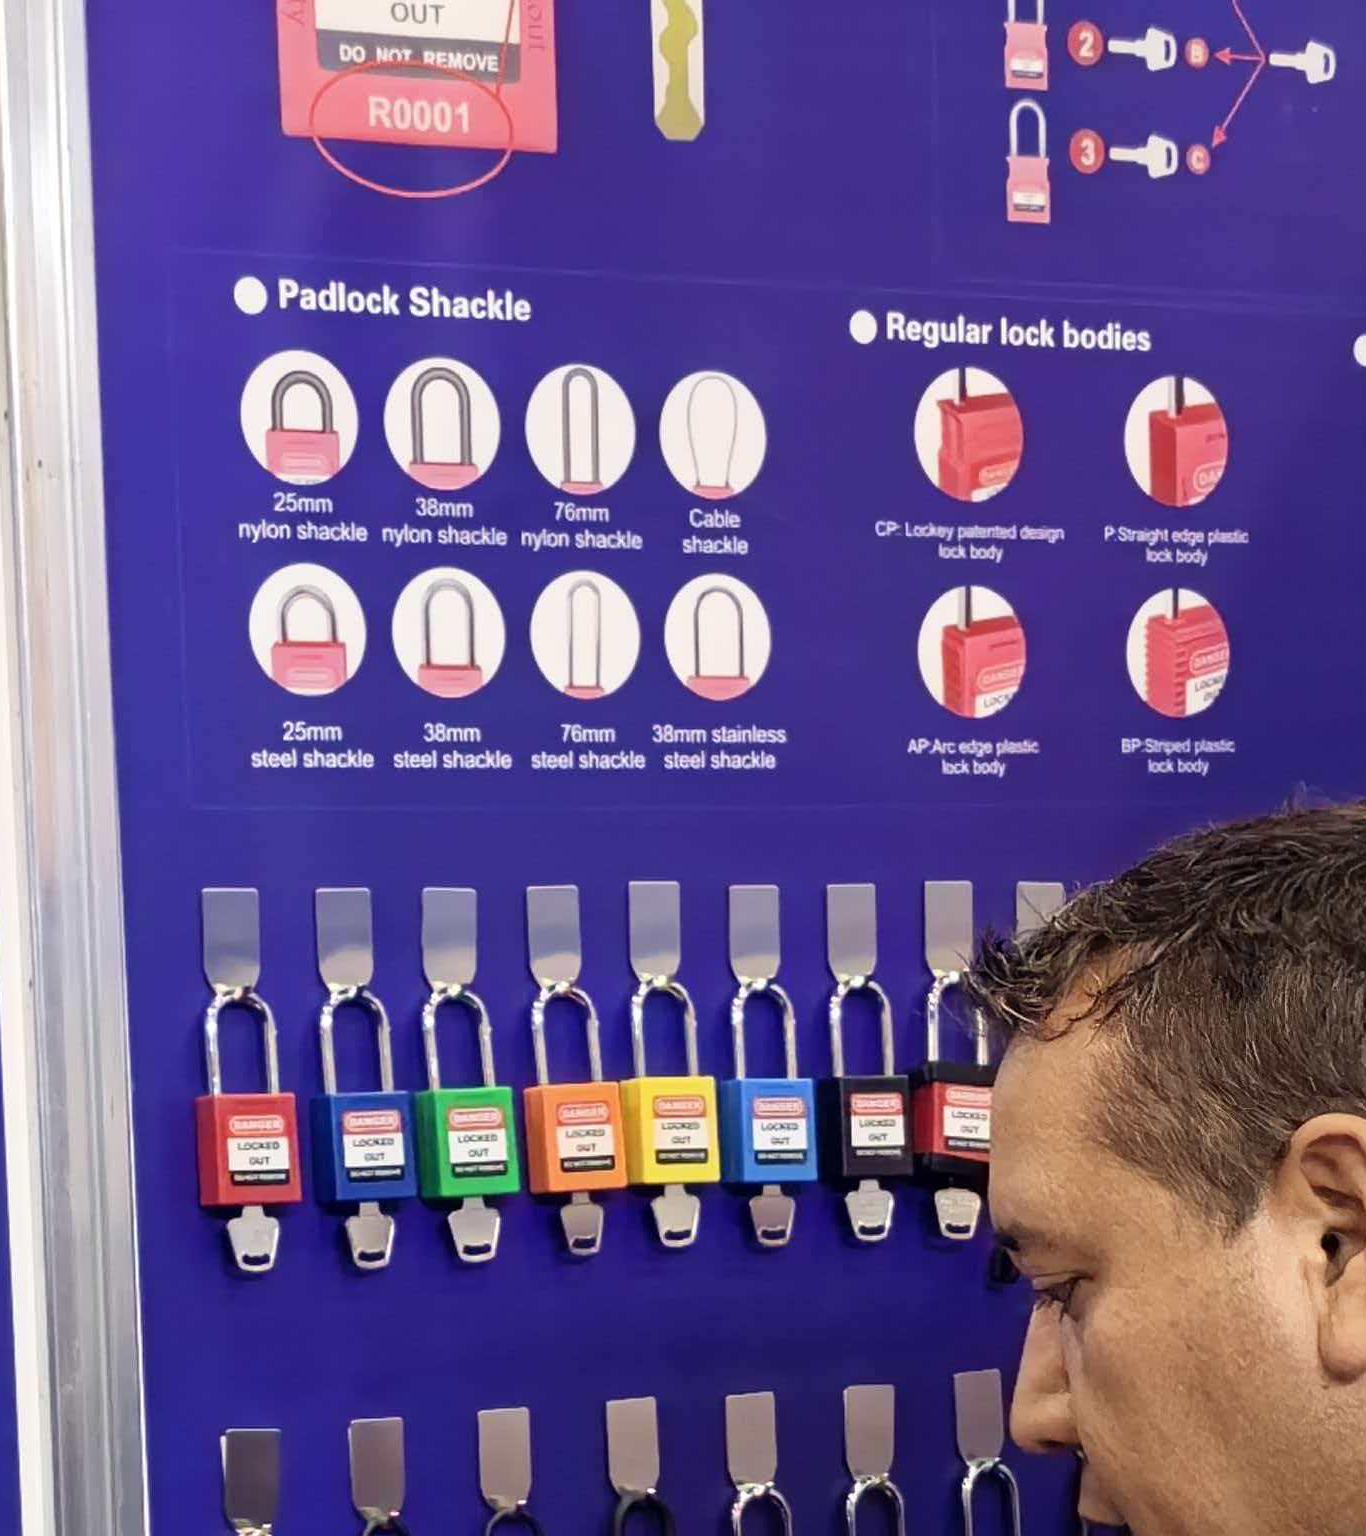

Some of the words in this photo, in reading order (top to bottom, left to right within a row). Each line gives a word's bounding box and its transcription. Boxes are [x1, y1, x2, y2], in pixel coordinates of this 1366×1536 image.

[391, 2, 445, 24] OUT
[1079, 31, 1095, 57] 2
[339, 44, 366, 63] DO
[377, 48, 414, 64] NOT
[424, 52, 500, 73] REMOVE
[368, 96, 470, 134] R0001
[1080, 138, 1096, 165] 3
[278, 279, 399, 317] Padlock
[409, 286, 532, 322] Shackle
[887, 312, 992, 348] Regular
[1000, 318, 1055, 348] lock
[1063, 320, 1152, 352] bodies
[273, 492, 333, 513] 25mm
[415, 497, 474, 518] 38mm
[554, 502, 609, 522] 76mm
[689, 508, 741, 529] Cable
[238, 520, 291, 543] nylon
[297, 521, 368, 542] shackle
[382, 524, 432, 547] nylon
[438, 525, 507, 546] shackle
[521, 529, 569, 551] nylon
[575, 529, 643, 550] shackle
[905, 522, 954, 542] Lockey
[958, 525, 1017, 541] patented
[1020, 526, 1065, 544] design
[1171, 529, 1205, 547] edge
[1208, 528, 1250, 547] plastic
[683, 535, 749, 555] shackle
[939, 543, 966, 559] lock
[970, 544, 1003, 564] body
[1146, 548, 1173, 563] lock
[1176, 549, 1208, 567] body
[283, 721, 343, 741] 25mm
[423, 723, 482, 742] 38mm
[560, 724, 616, 743] 76mm
[652, 724, 706, 743] 38mm
[712, 725, 787, 743] stainless
[958, 739, 993, 758] edge
[996, 739, 1040, 757] plastic
[1194, 738, 1236, 757] plastic
[251, 749, 297, 768] steel
[303, 749, 375, 768] shackle
[393, 750, 437, 769] steel
[443, 750, 513, 769] shackle
[531, 750, 573, 769] steel
[579, 750, 646, 769] shackle
[664, 750, 705, 769] steel
[710, 750, 776, 769] shackle
[941, 759, 969, 775] lock
[973, 760, 1006, 777] body
[1147, 759, 1174, 773] lock
[1177, 759, 1209, 777] body
[565, 1128, 605, 1138] LOCKED
[661, 1121, 700, 1131] LOCKED
[761, 1122, 799, 1132] LOCKED
[858, 1119, 896, 1128] LOCKED
[237, 1140, 280, 1151] LOCKED
[352, 1137, 395, 1148] LOCKED
[457, 1133, 498, 1143] LOCKED
[575, 1143, 597, 1152] OUT
[671, 1136, 692, 1145] OUT
[249, 1156, 271, 1166] OUT
[364, 1152, 386, 1162] OUT
[468, 1148, 489, 1158] OUT
